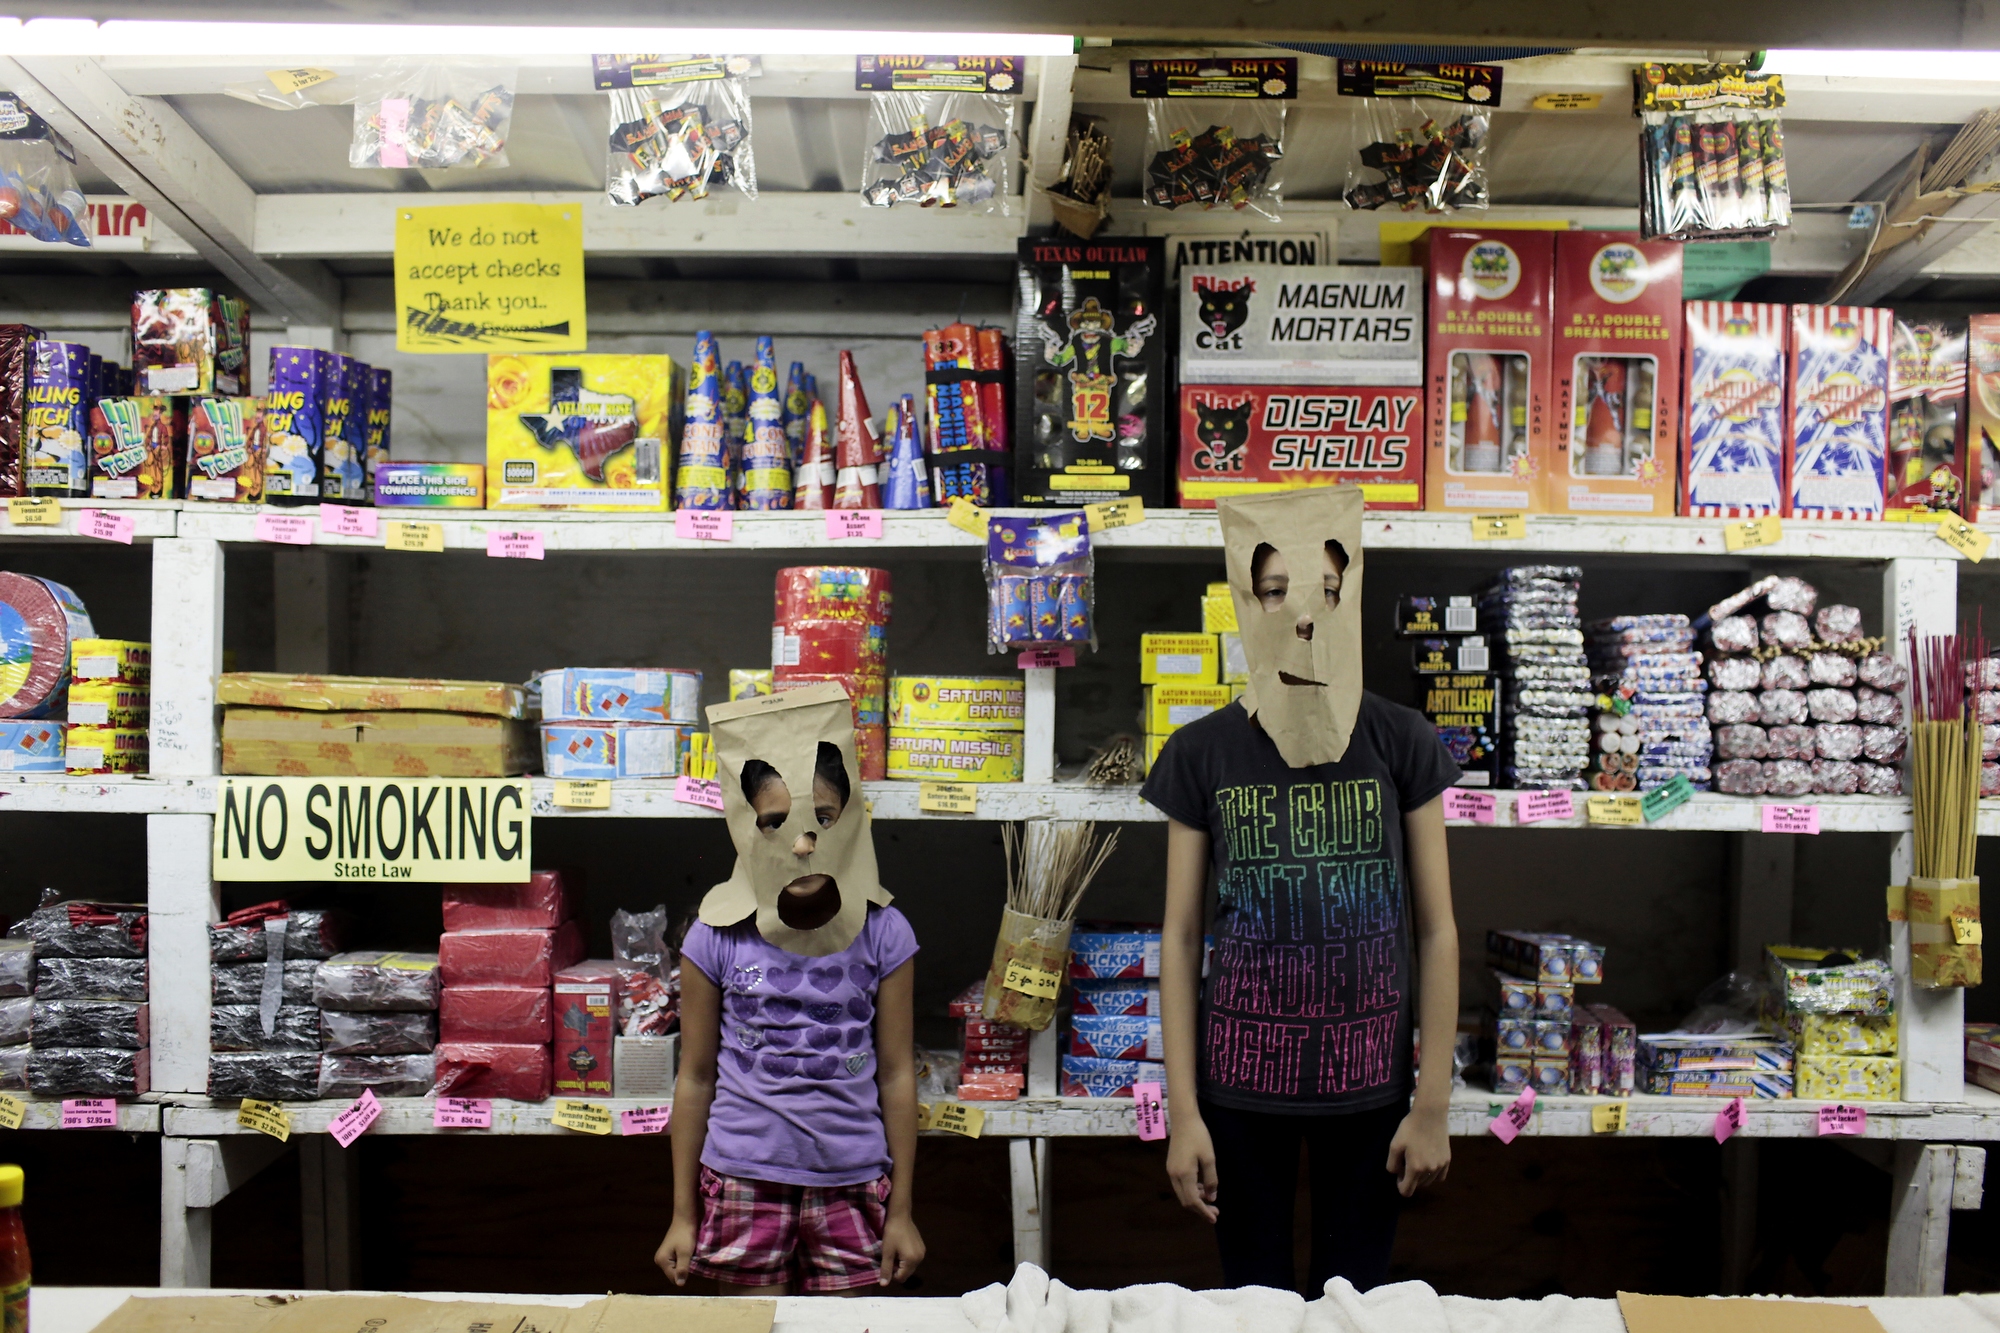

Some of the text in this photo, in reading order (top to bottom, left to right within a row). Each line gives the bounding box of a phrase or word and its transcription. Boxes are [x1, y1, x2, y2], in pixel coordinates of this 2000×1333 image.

[957, 55, 1014, 71] BATS
[1152, 61, 1287, 77] MAD BATS
[1439, 63, 1493, 83] BATS
[1656, 80, 1769, 101] MILITARY SMOKE
[429, 227, 539, 247] We do not
[1032, 246, 1149, 263] TEXAS OUTLAW
[1173, 240, 1316, 280] ATTENTION
[409, 258, 562, 284] accept checks
[1192, 275, 1256, 294] Black
[1278, 284, 1405, 309] MAGNUM
[1446, 310, 1534, 323] B.T. DOUBLE
[1572, 313, 1662, 327] B.T. DOUBLE
[1270, 317, 1413, 342] MORTARS
[1437, 322, 1542, 337] BREAK SHELLS
[1563, 326, 1670, 340] BREAK SHELLS
[1196, 331, 1243, 350] Cat
[558, 401, 632, 416] YELLOW ROSE
[1074, 393, 1110, 420] 12
[1263, 396, 1417, 430] DISPLAY
[1433, 375, 1445, 449] MAXIMUM
[1533, 394, 1542, 435] LOAD
[1558, 379, 1570, 452] MAXIMUM
[1659, 398, 1669, 438] LOAD
[1193, 449, 1245, 472] Cat
[1269, 436, 1410, 471] SHELLS
[388, 476, 467, 487] PLACE THIS SIDE
[379, 487, 477, 497] TOWARDS AUDIENCE
[820, 571, 863, 585] BIG
[1414, 612, 1431, 622] 12
[1406, 622, 1439, 632] SHOTS
[1149, 638, 1210, 646] SATURN MISSILES
[1190, 647, 1213, 655] SHOTS
[1427, 652, 1443, 663] 12
[1419, 662, 1452, 671] SHOTS
[1434, 676, 1486, 688] 12 SHOT
[938, 688, 1024, 704] SATURN MIS
[1426, 689, 1495, 713] ARTILLERY
[1435, 713, 1484, 727] SHELLS
[888, 737, 1013, 756] SATURN MISSILE
[909, 753, 987, 770] BATTERY
[222, 783, 523, 862] NO SMOKING
[1216, 778, 1383, 861] THE CLUB
[335, 862, 412, 878] State Law
[1317, 858, 1401, 939] EVEN
[1074, 953, 1141, 967] CUCKOO
[1006, 971, 1019, 983] 5
[1357, 934, 1400, 1013] ME
[1077, 992, 1144, 1006] CUCKOO
[963, 1005, 972, 1013] 6
[978, 1024, 1010, 1035] 6 PCS
[981, 1038, 1013, 1047] 6 PCS
[1076, 1032, 1144, 1048] CUCKOO
[978, 1053, 1011, 1061] 6 PCS
[1207, 1010, 1399, 1095] RIGHT NOW
[973, 1066, 1006, 1074] 6 PCS
[1673, 1073, 1711, 1082] SPACE
[1068, 1073, 1134, 1088] CUCKOO
[64, 1117, 82, 1125] 200's
[86, 1116, 103, 1124] $2.95
[240, 1116, 257, 1126] 200's
[261, 1121, 277, 1133] $2.95
[441, 1115, 455, 1123] 50's
[584, 1114, 609, 1123] Cracker
[341, 1127, 357, 1142] 100's
